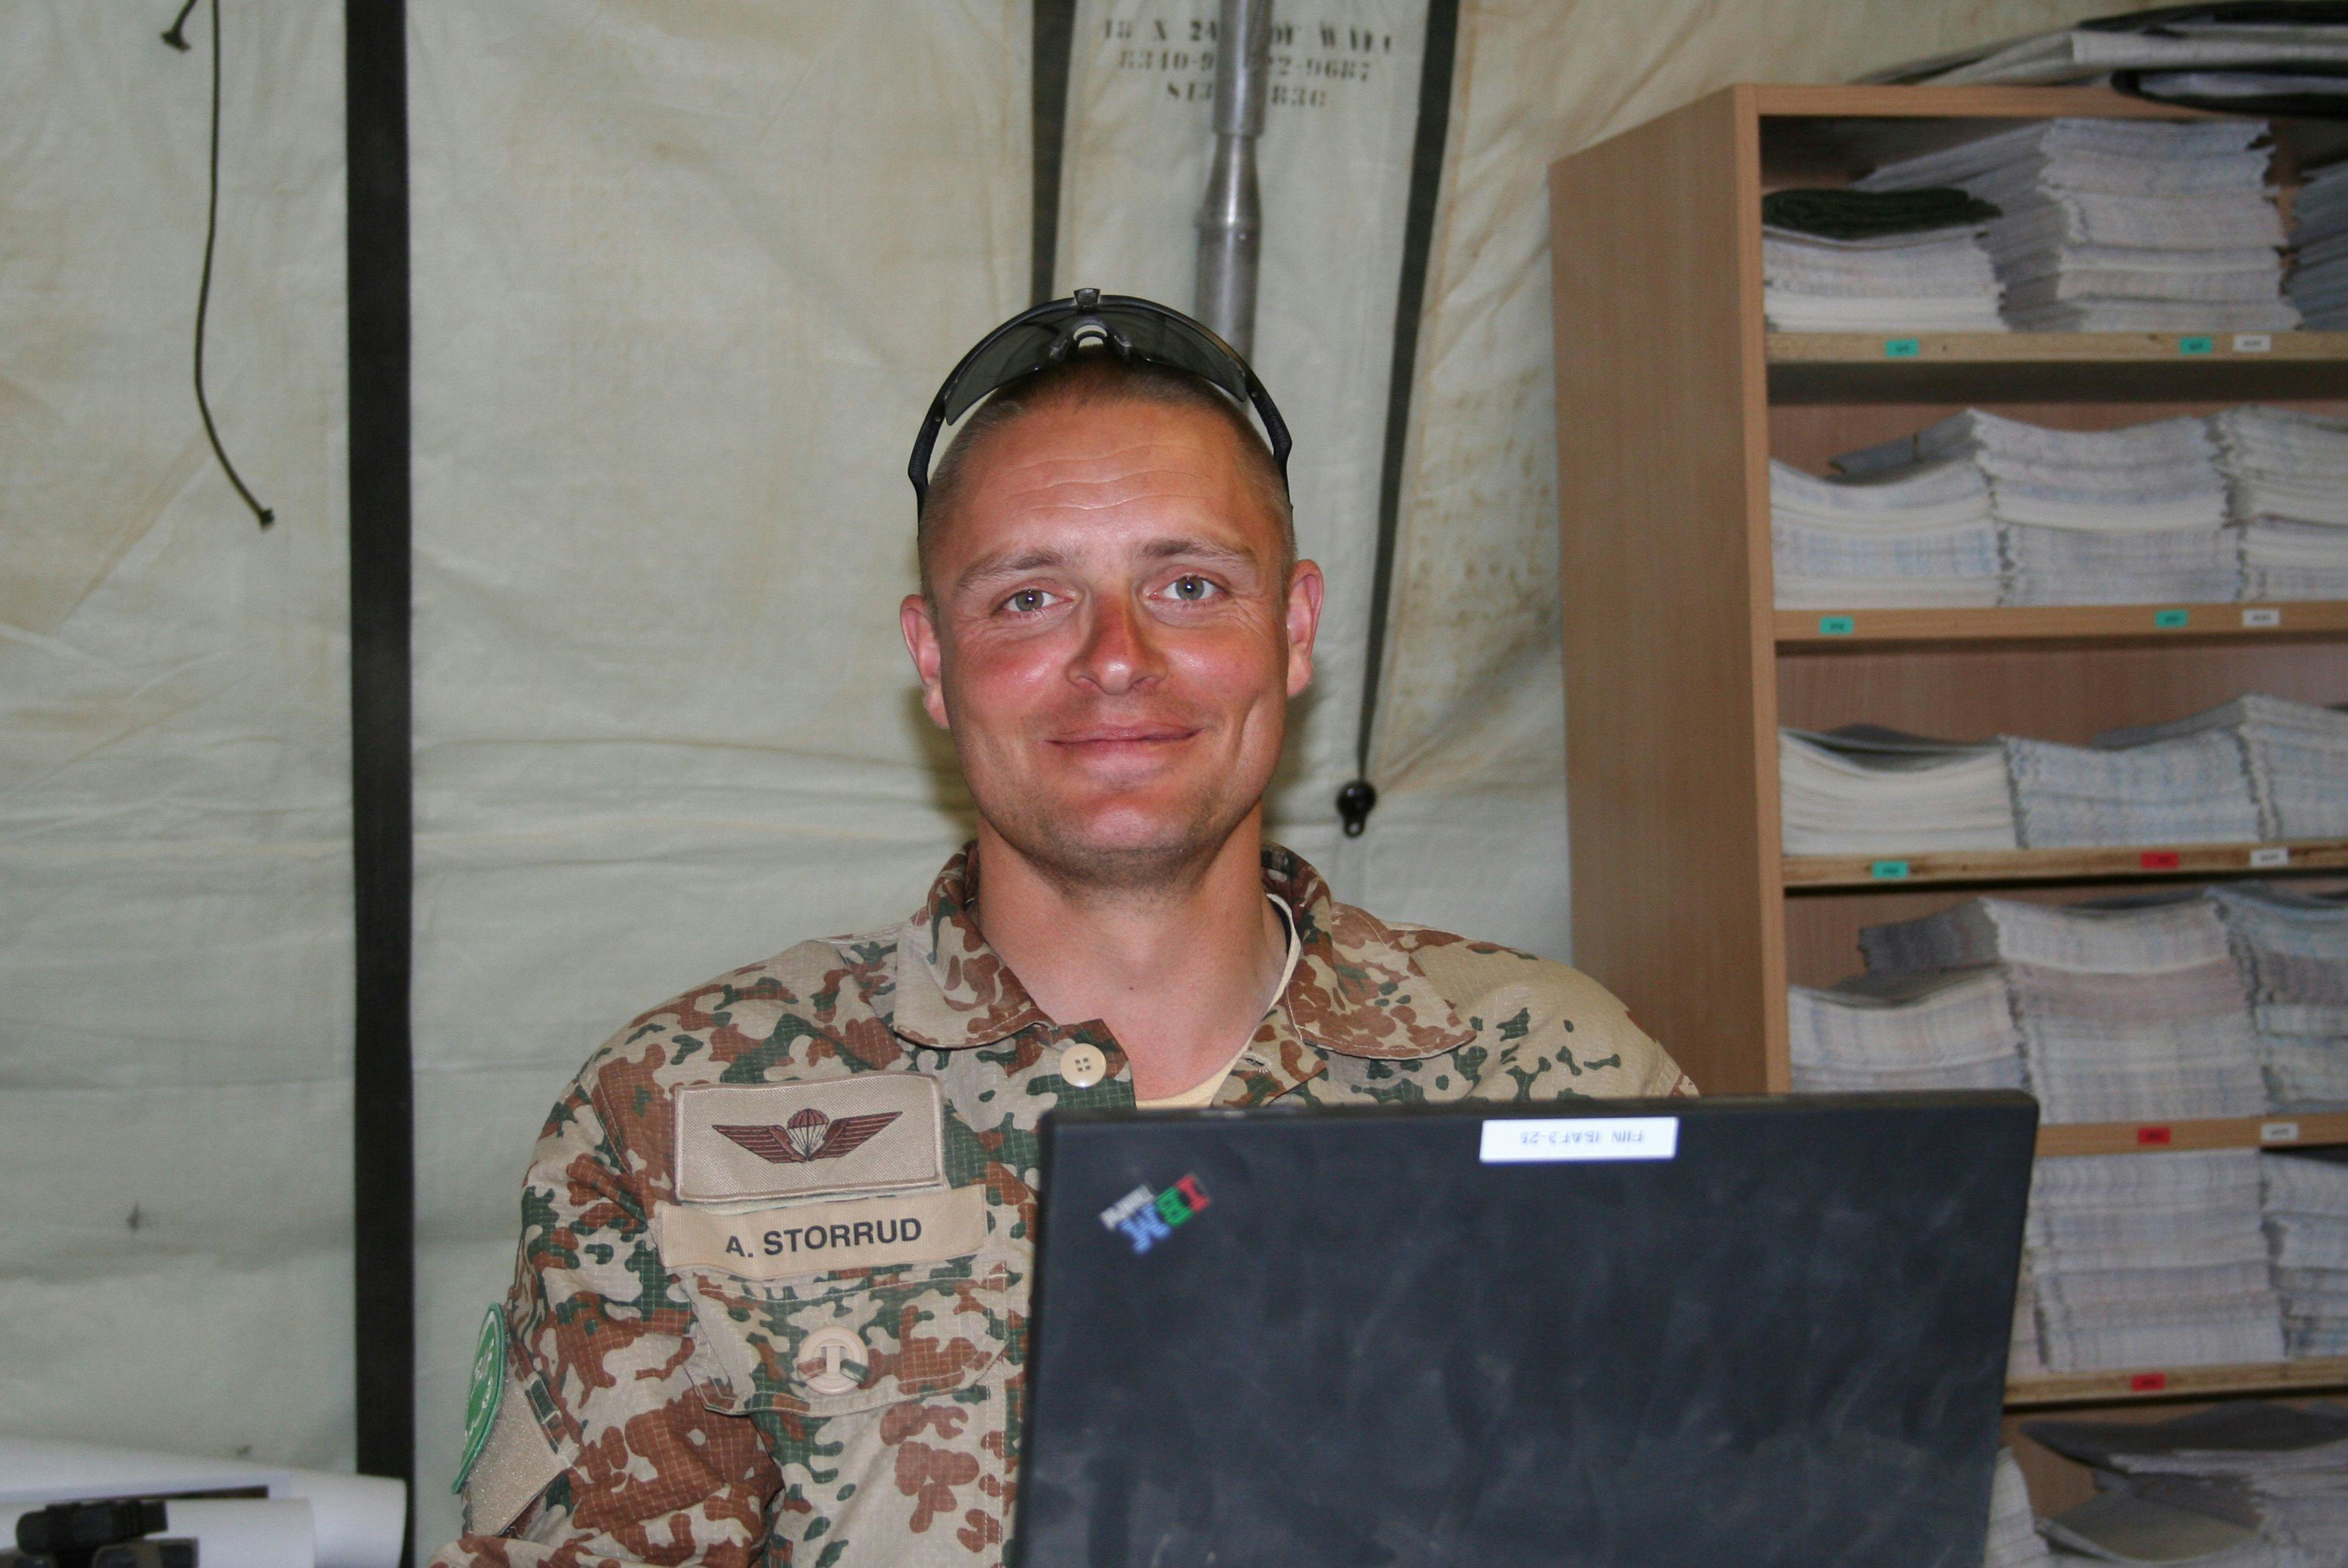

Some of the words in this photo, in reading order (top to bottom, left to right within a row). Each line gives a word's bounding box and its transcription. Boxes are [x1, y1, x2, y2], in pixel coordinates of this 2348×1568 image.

[726, 1235, 754, 1258] A.
[763, 1217, 922, 1255] STORRUD
[1119, 1174, 1210, 1254] IBM
